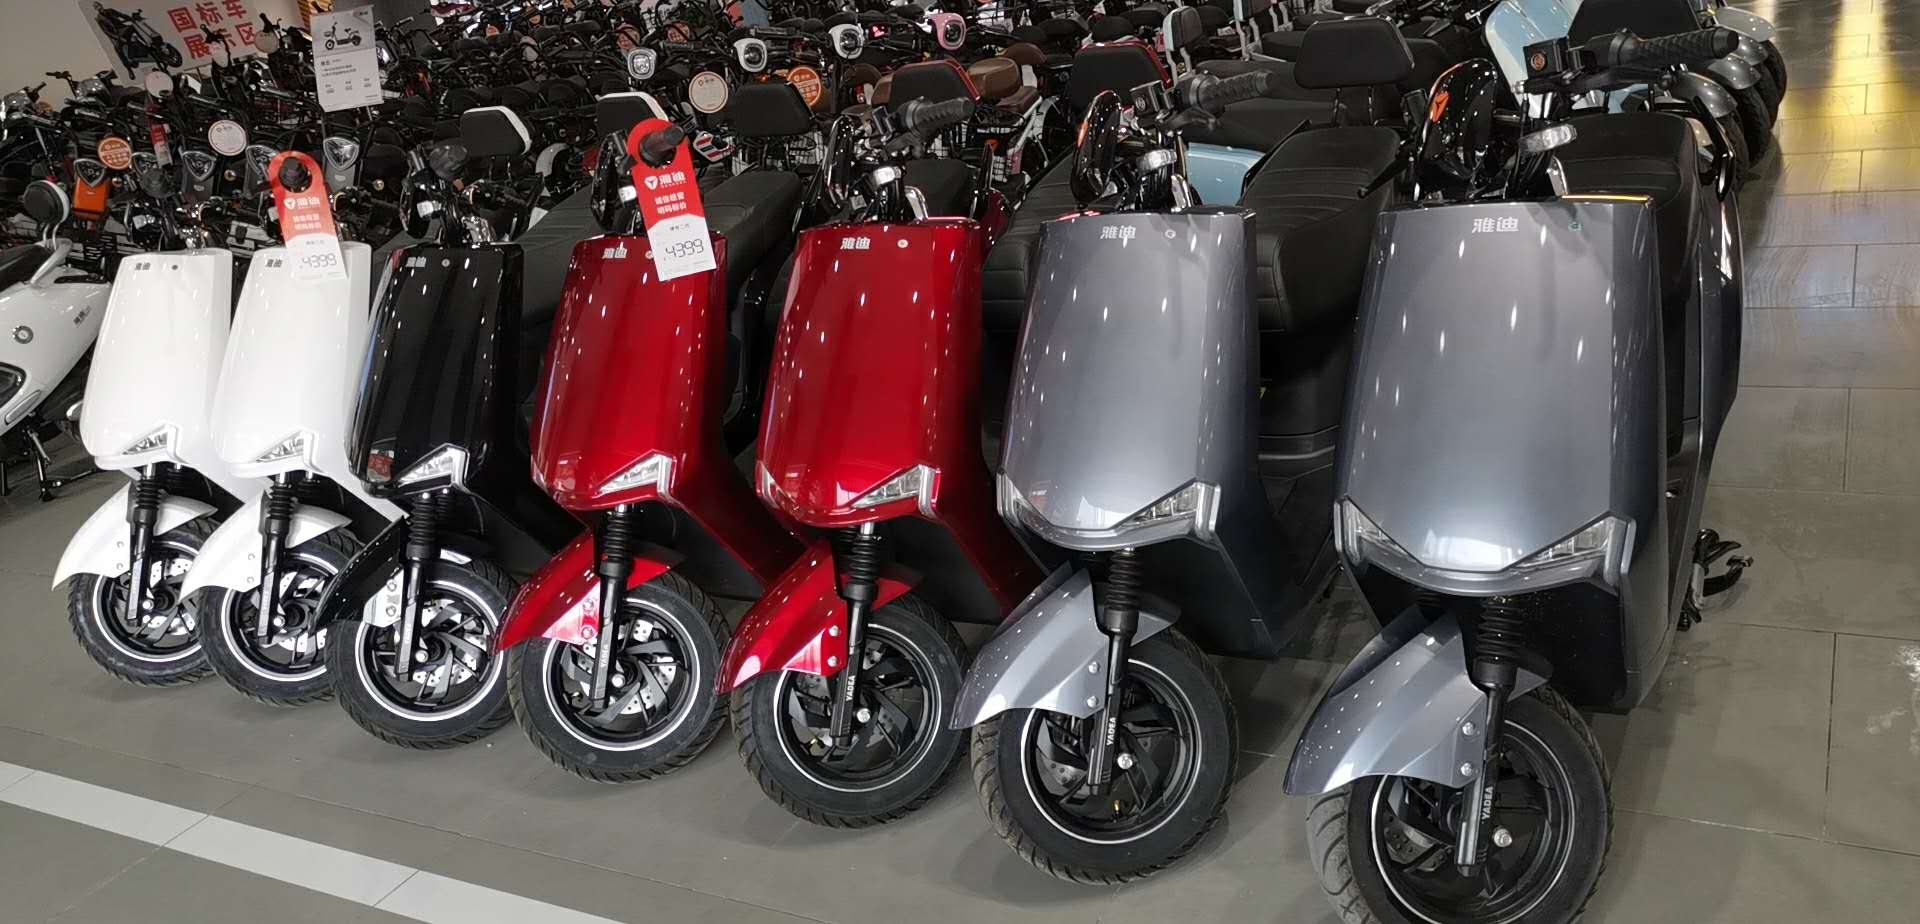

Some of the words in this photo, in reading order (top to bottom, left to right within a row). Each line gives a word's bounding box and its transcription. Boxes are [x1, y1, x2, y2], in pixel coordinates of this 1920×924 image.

[167, 0, 247, 33] 国标车
[1100, 224, 1136, 239] 雅迪
[1471, 216, 1519, 233] 雅迪
[840, 236, 871, 250] 雅迪
[846, 675, 856, 702] YADEA
[1106, 717, 1116, 746] YADEA
[1481, 786, 1494, 820] YADEA
